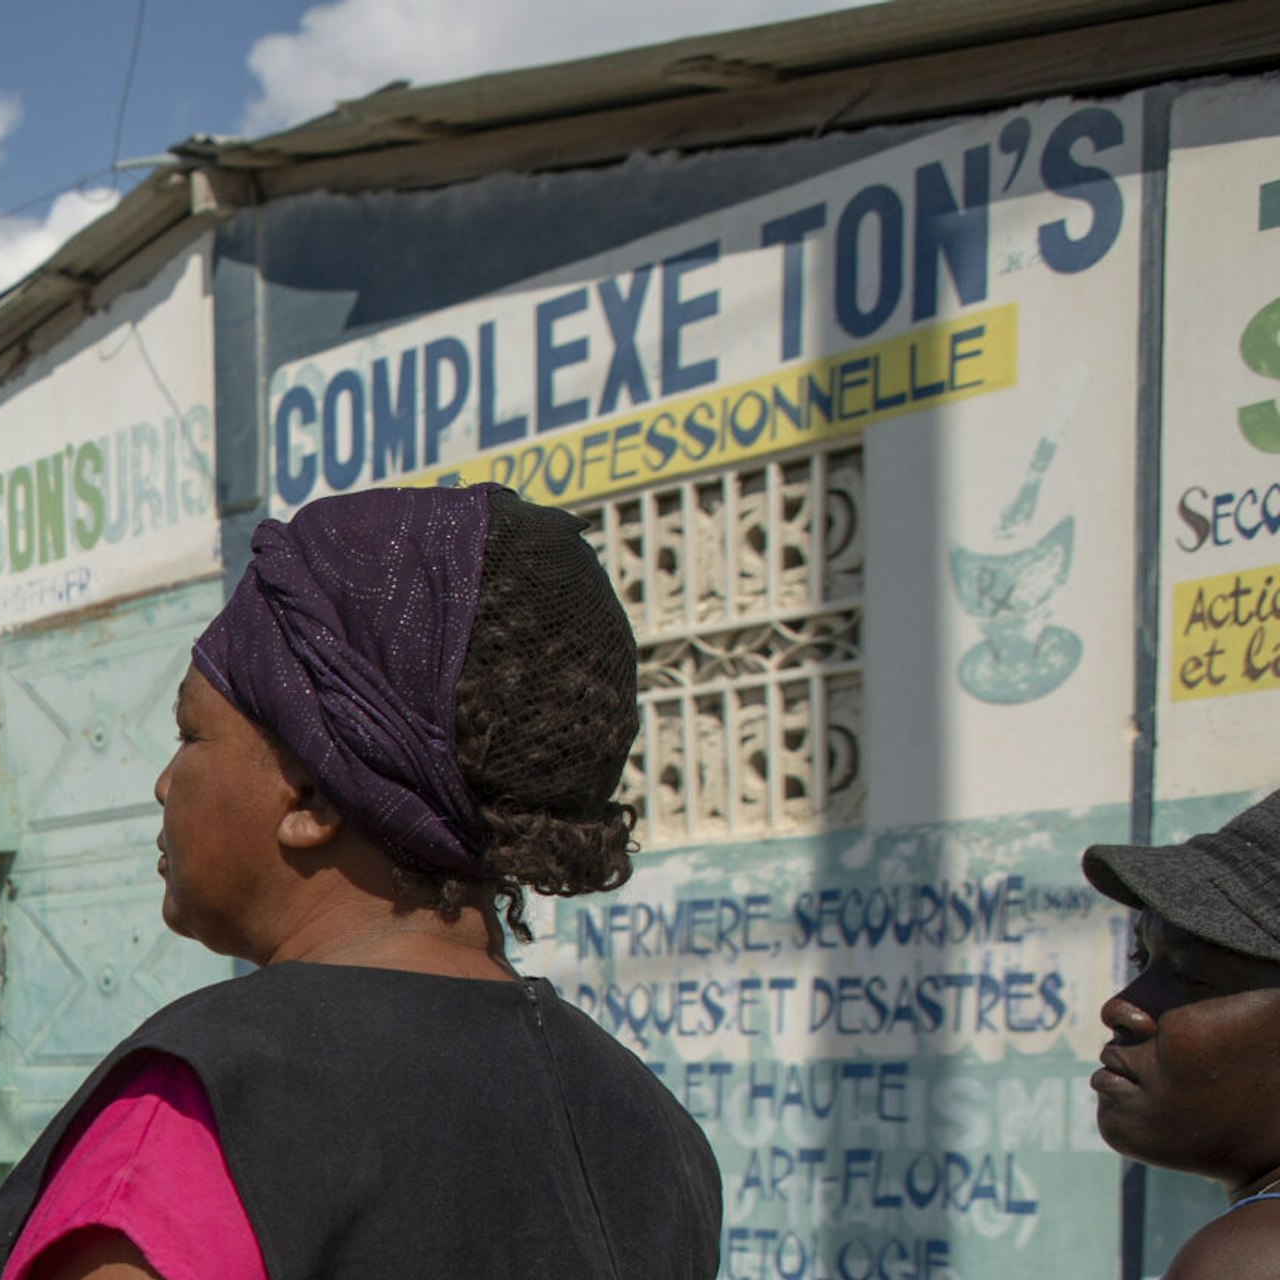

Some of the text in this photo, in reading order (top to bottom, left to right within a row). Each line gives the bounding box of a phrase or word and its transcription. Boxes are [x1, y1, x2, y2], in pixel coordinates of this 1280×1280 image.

[274, 107, 1125, 507] COMPLEXE TON'S
[491, 325, 986, 500] PROFESSIONNELLE
[1180, 639, 1227, 690] et
[739, 976, 797, 1036] ET
[682, 1061, 910, 1123] ET HAUTE
[739, 1147, 1038, 1216] ART-FLORAL
